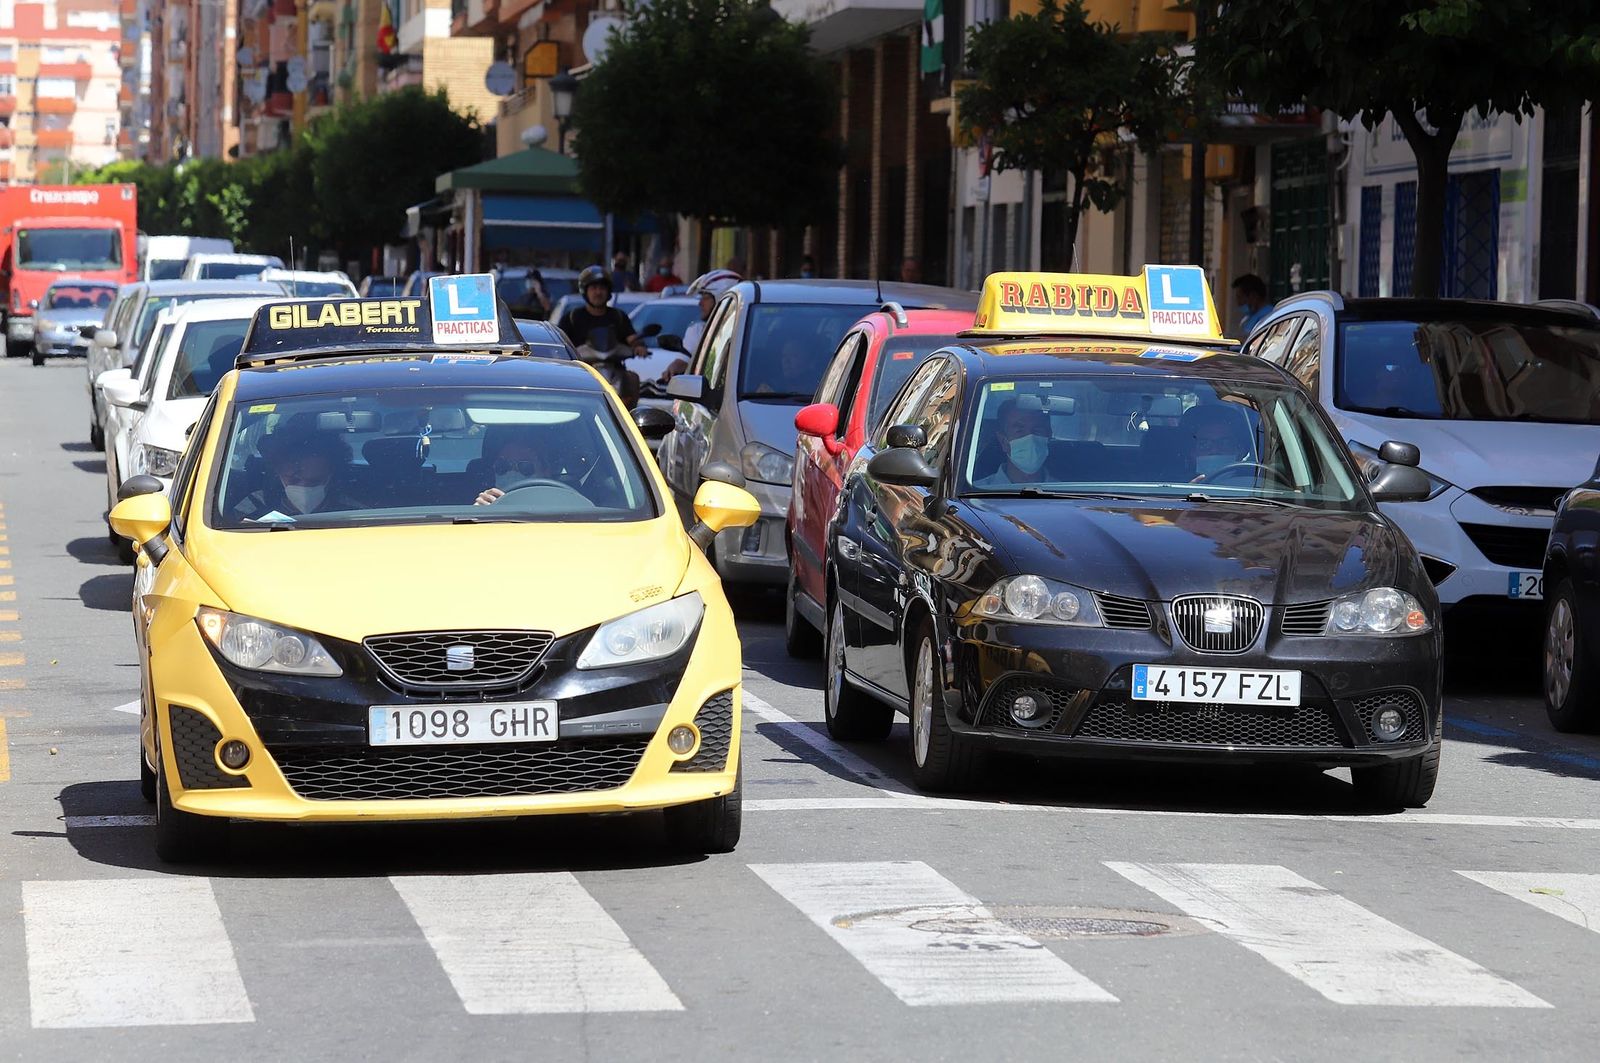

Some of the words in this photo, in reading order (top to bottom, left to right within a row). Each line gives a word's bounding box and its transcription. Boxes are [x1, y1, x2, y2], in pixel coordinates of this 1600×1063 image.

[447, 284, 479, 315] L
[1000, 281, 1145, 319] RABIDA
[1161, 274, 1190, 304] L
[269, 300, 421, 330] GILABERT
[365, 326, 420, 334] Formación
[437, 321, 494, 335] PRACTICAS
[1152, 311, 1204, 325] PRACTICAS
[1137, 685, 1144, 694] E
[1155, 670, 1227, 698] 4157
[1238, 674, 1291, 701] FZL
[391, 710, 470, 740] 1098
[490, 707, 550, 738] GHR
